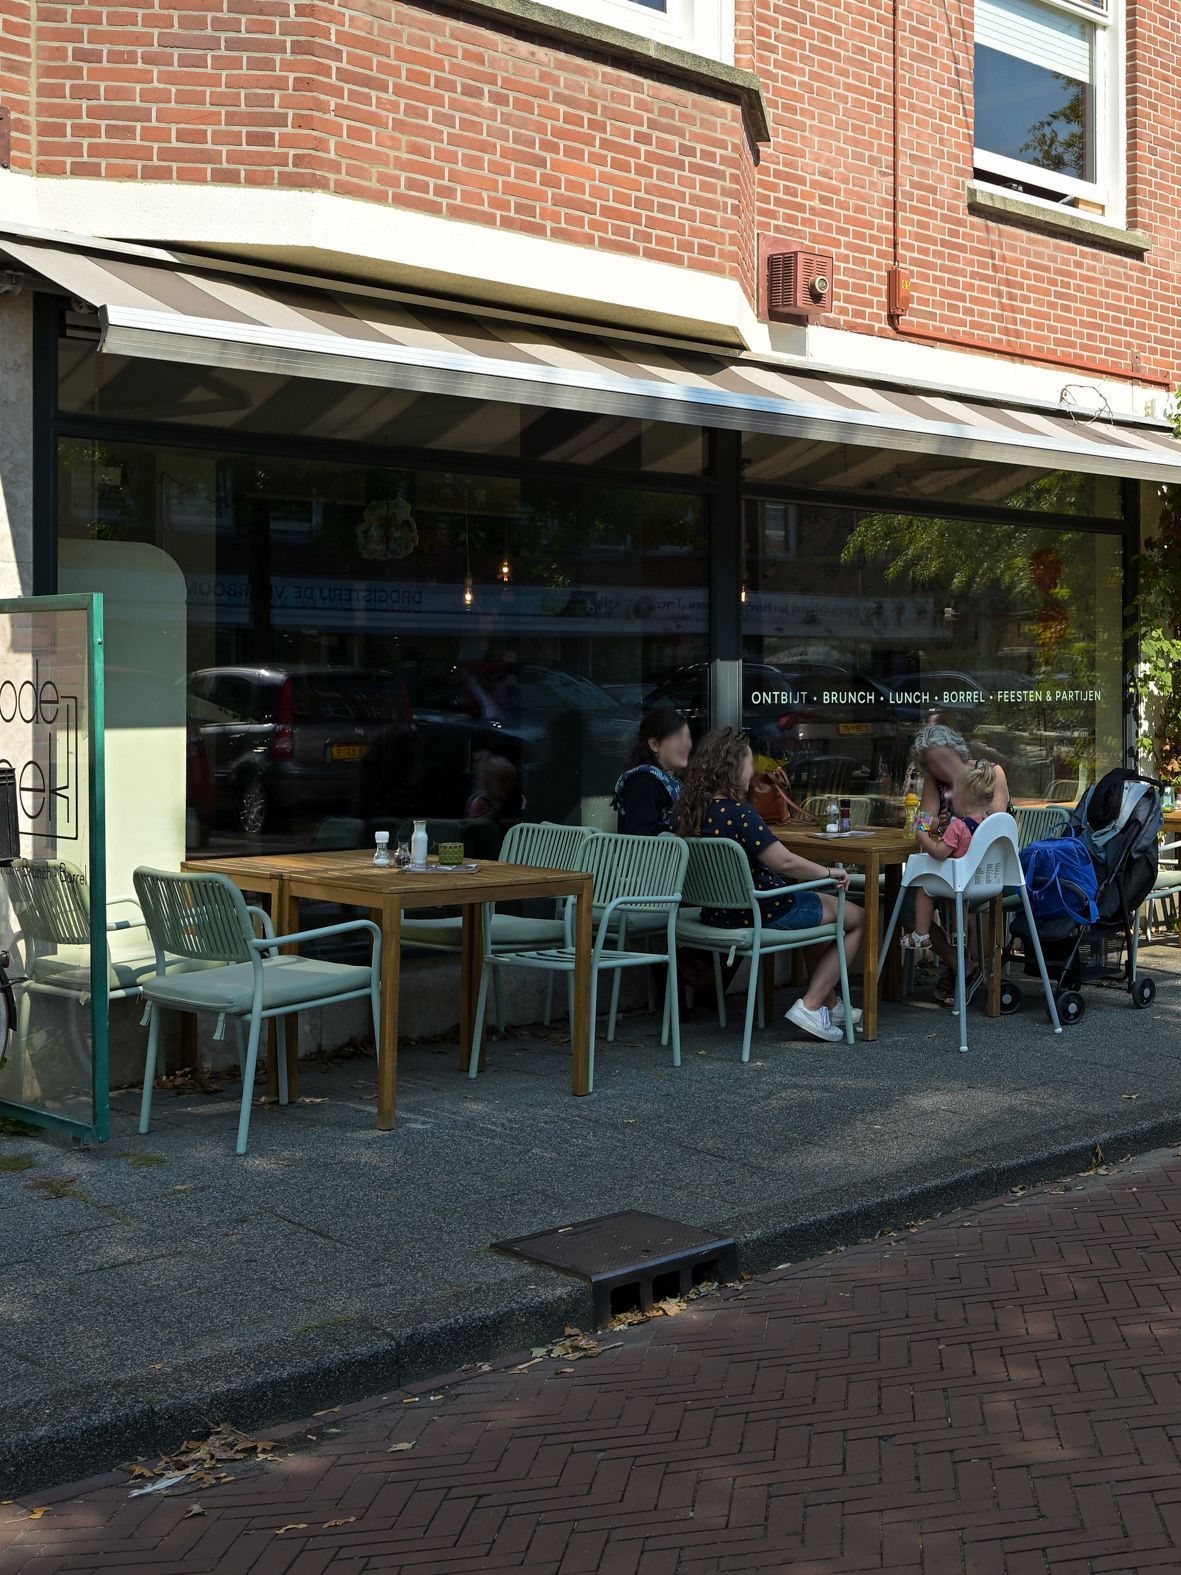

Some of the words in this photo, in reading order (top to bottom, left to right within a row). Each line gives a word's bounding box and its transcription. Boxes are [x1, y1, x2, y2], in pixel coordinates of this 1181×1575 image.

[751, 690, 809, 705] ONTBIJT
[822, 690, 876, 704] BRUNCH
[888, 690, 931, 704] LUNCH
[943, 690, 986, 703] BORREL
[997, 689, 1043, 703] FEESTEN
[1045, 689, 1053, 702] &
[1055, 689, 1102, 702] PARTIJEN
